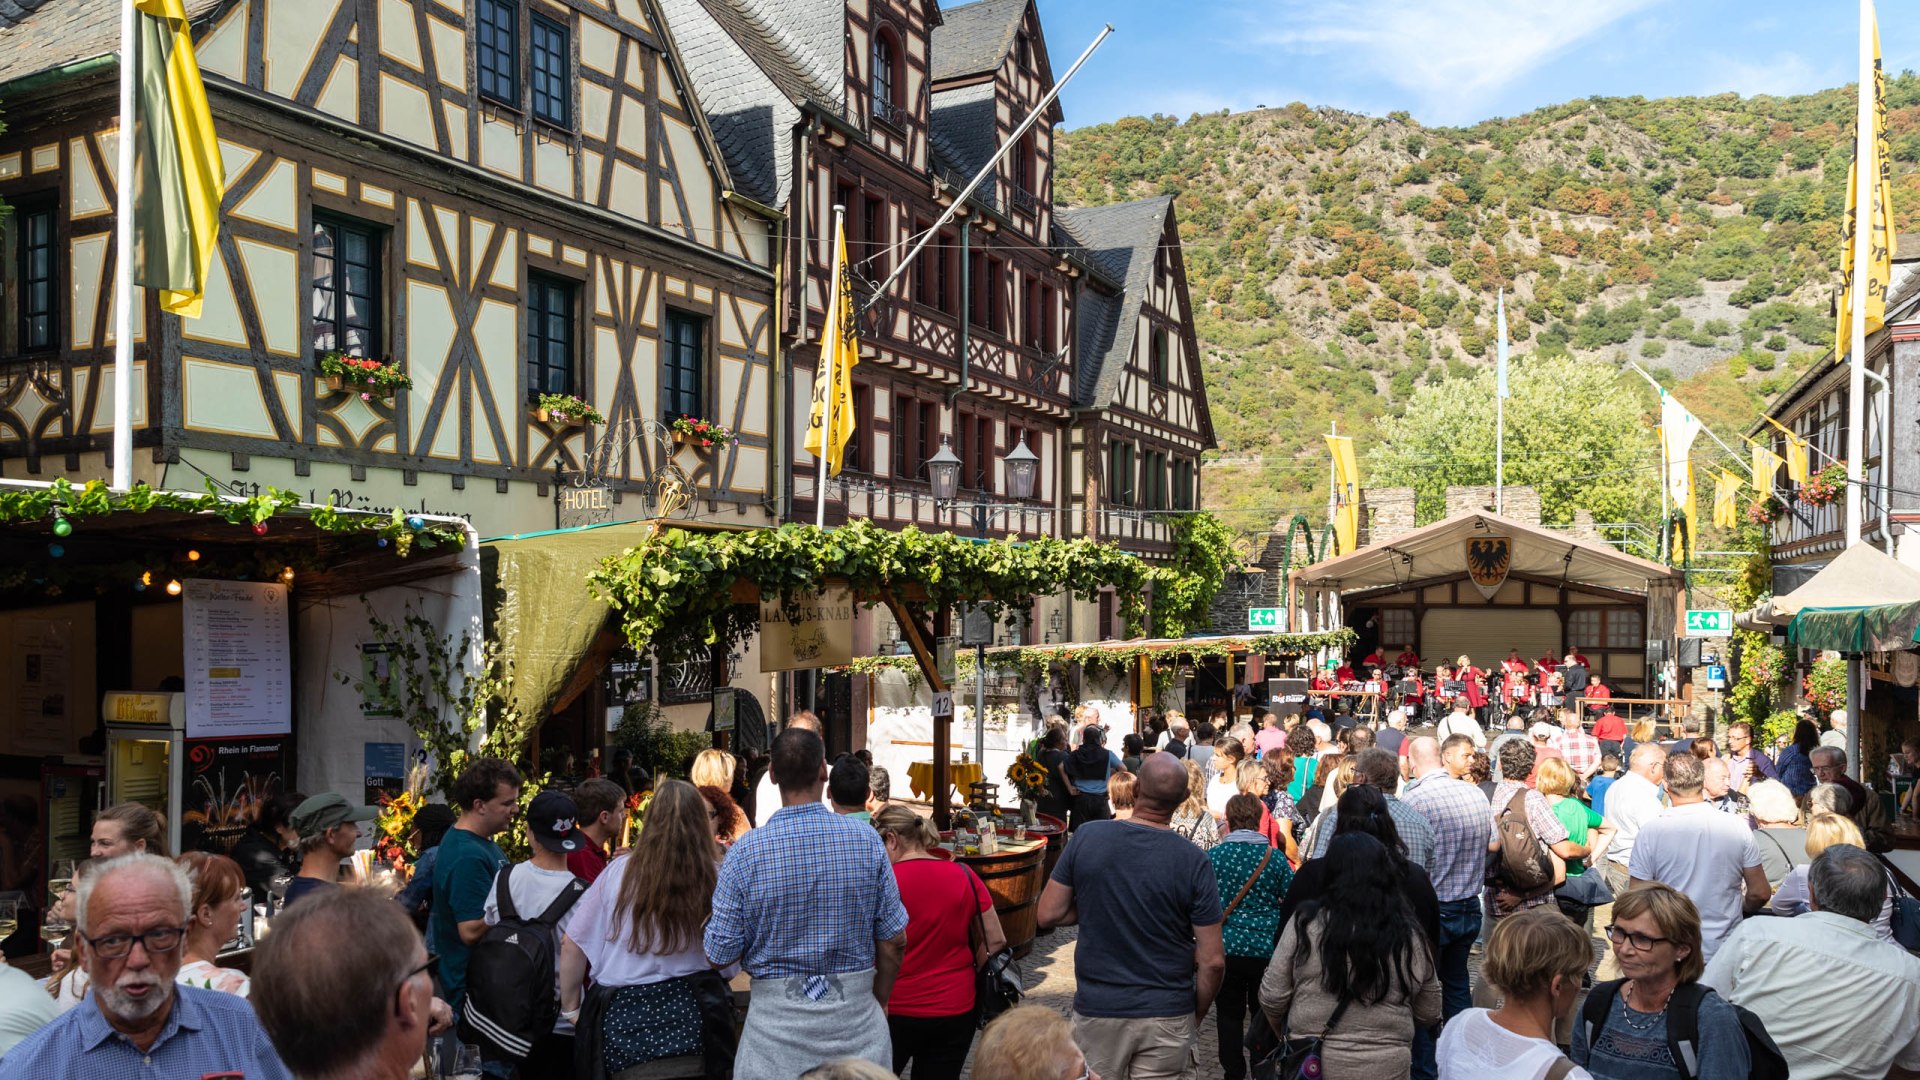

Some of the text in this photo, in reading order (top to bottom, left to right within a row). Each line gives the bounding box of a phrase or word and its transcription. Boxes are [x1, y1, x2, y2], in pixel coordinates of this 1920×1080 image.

[565, 490, 607, 510] HOTEL
[1711, 667, 1721, 679] P
[935, 696, 949, 714] 12
[218, 744, 279, 755] Rhein in Flammen
[366, 776, 384, 787] Gott
